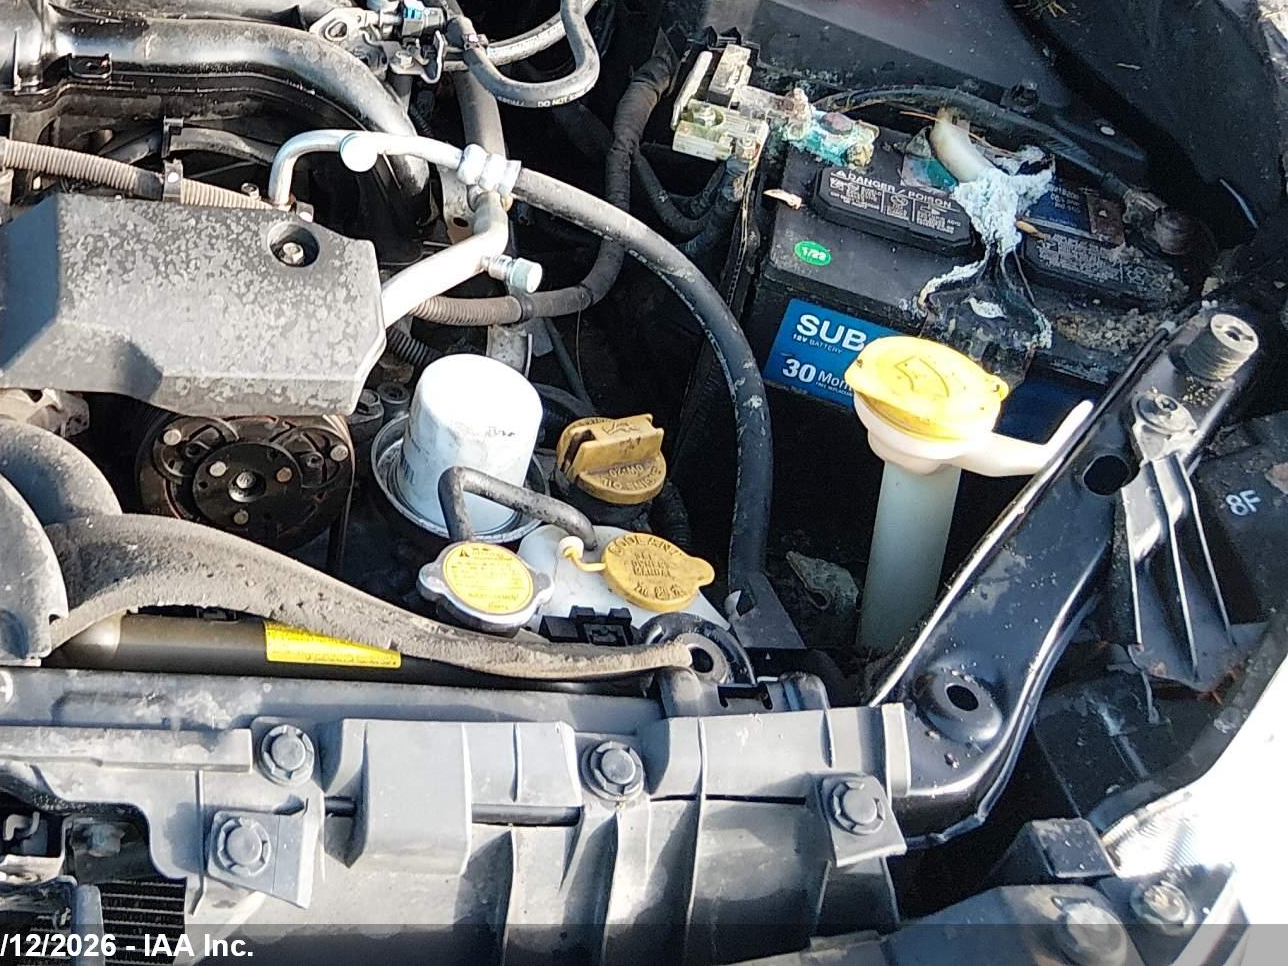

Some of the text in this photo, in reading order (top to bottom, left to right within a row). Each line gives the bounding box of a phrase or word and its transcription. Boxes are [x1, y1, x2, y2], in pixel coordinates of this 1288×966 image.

[537, 100, 551, 108] DO
[849, 173, 896, 193] DANGER
[908, 190, 952, 208] POISON
[796, 314, 867, 351] SUB
[809, 337, 843, 354] BATTERY
[782, 358, 853, 391] 30 Mon
[1225, 489, 1262, 517] 8F
